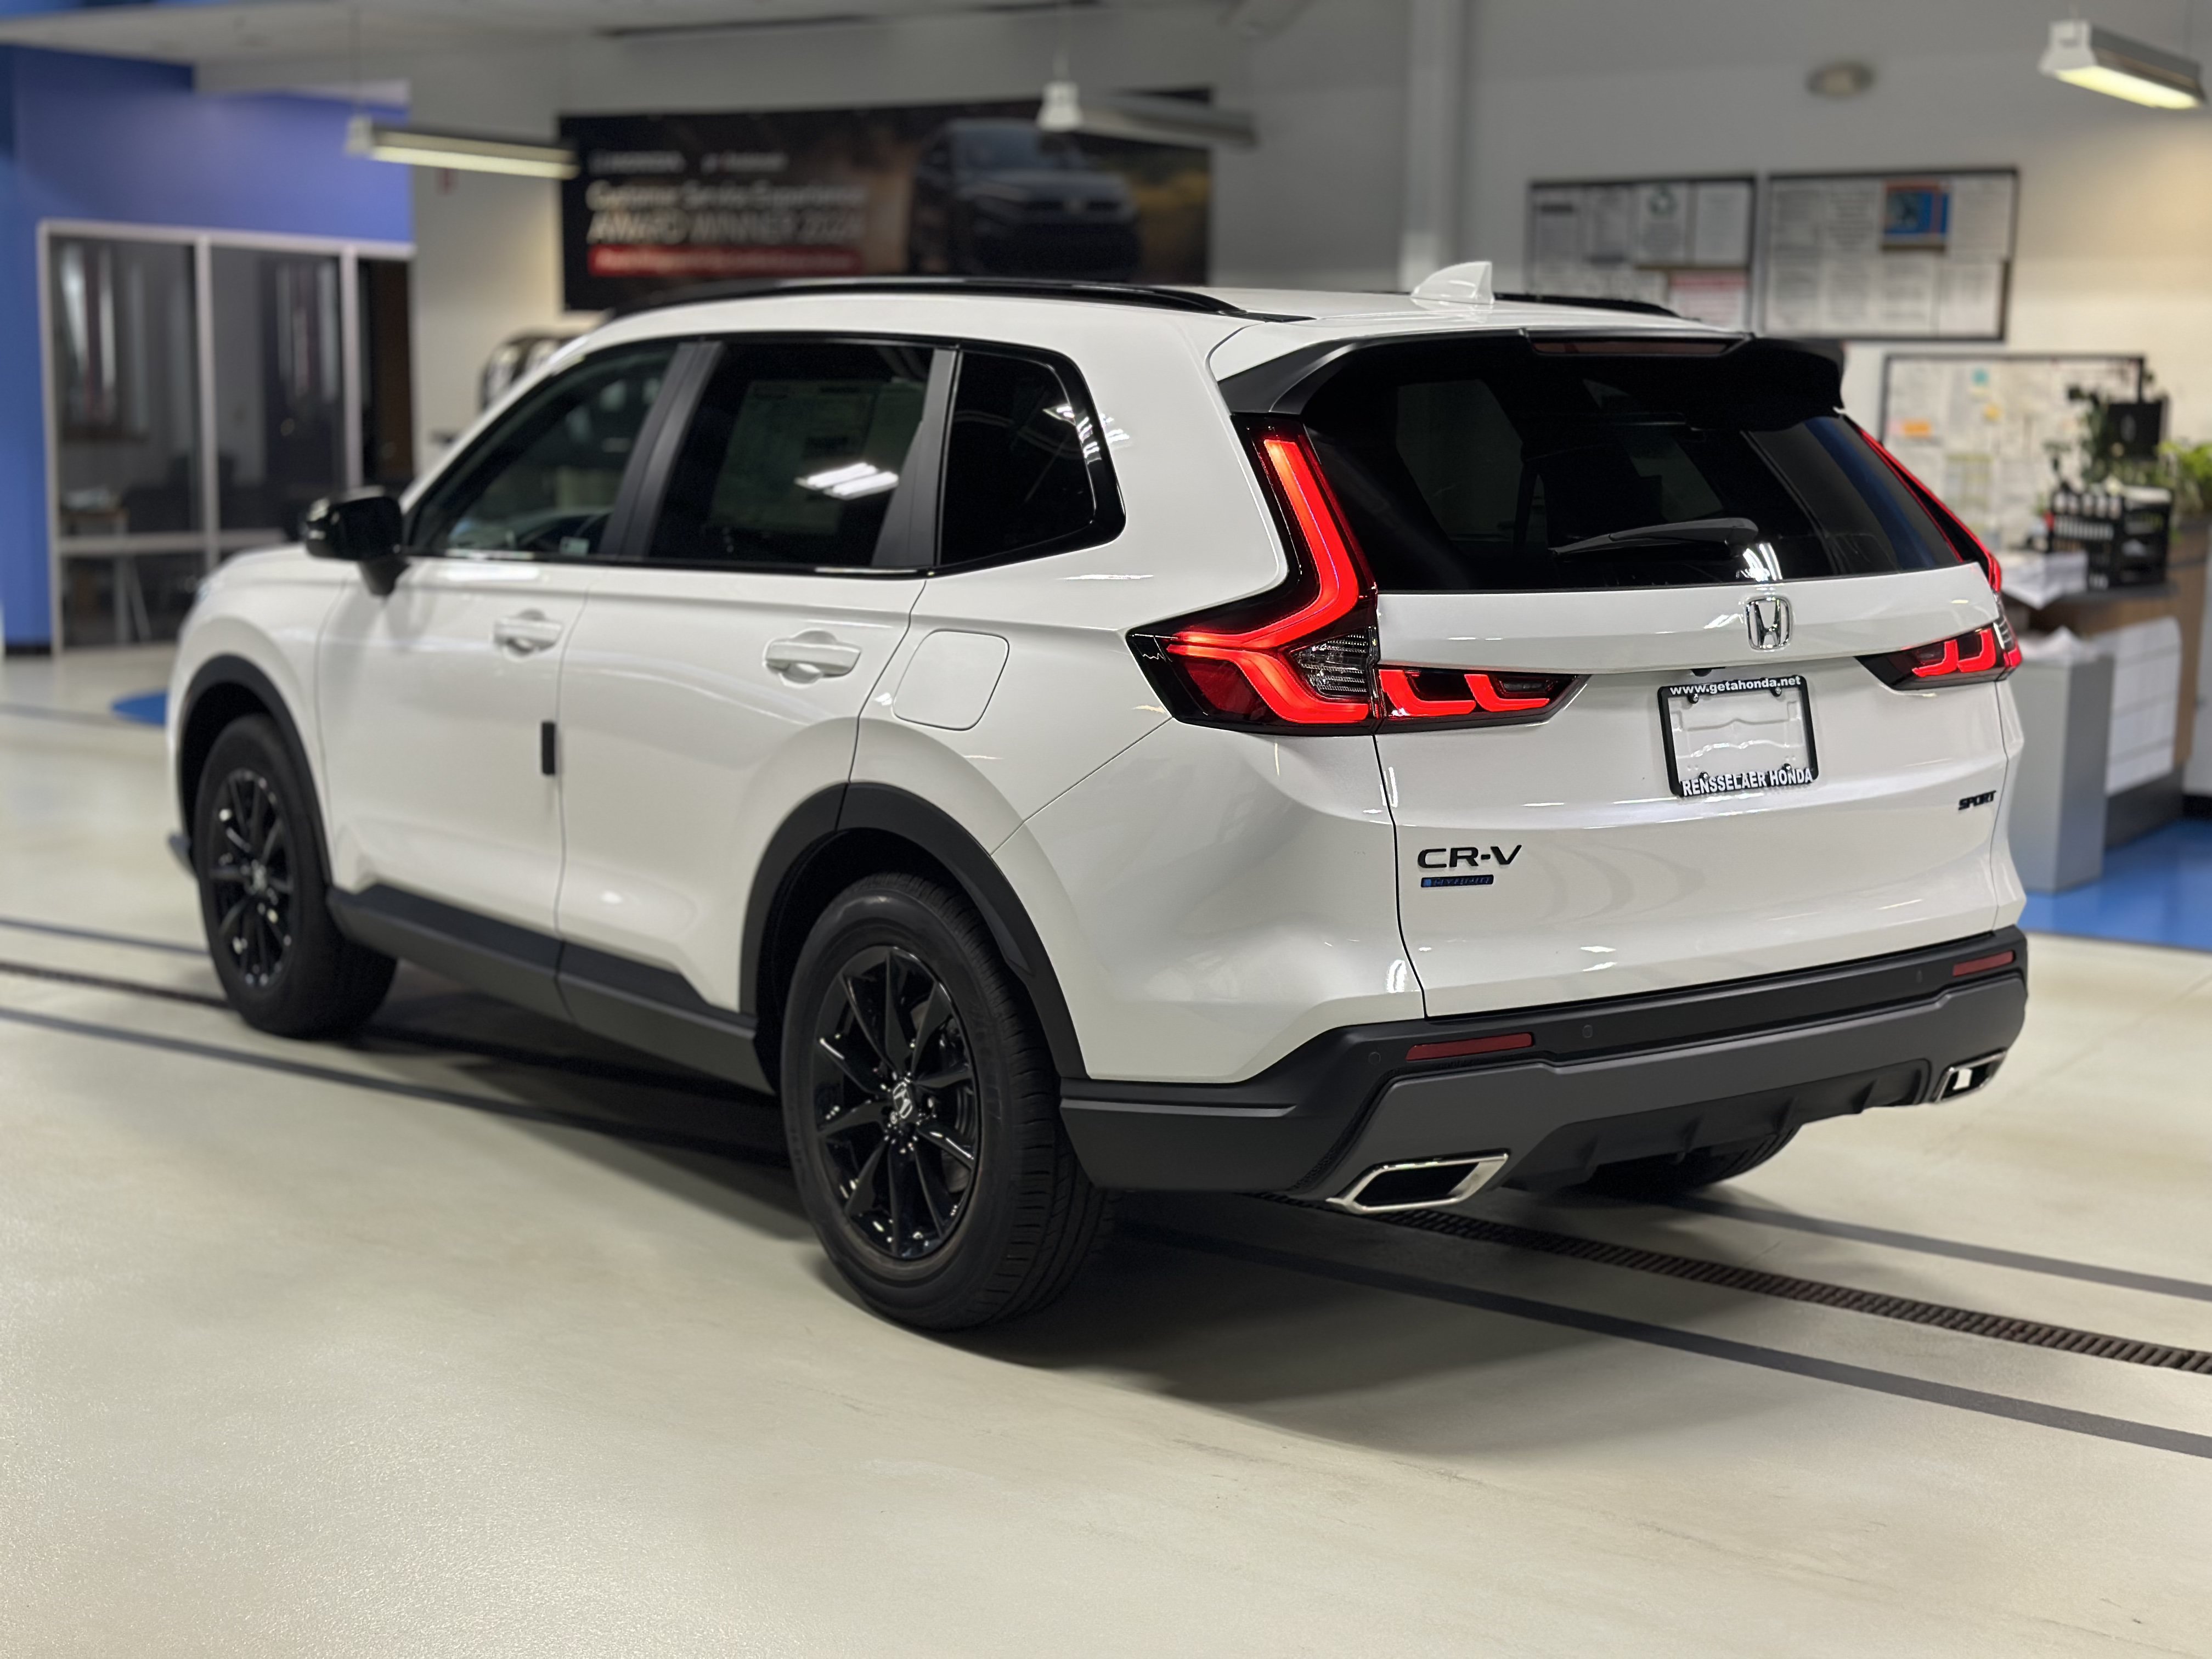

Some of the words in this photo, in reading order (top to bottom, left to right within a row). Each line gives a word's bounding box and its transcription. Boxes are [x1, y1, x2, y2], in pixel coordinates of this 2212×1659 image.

[1669, 675, 1801, 695] www.getahonda.net
[1682, 771, 1768, 796] RENSSELAER
[1770, 768, 1813, 786] HONDA
[1958, 790, 1996, 810] SPORT
[1417, 844, 1522, 868] CR-V
